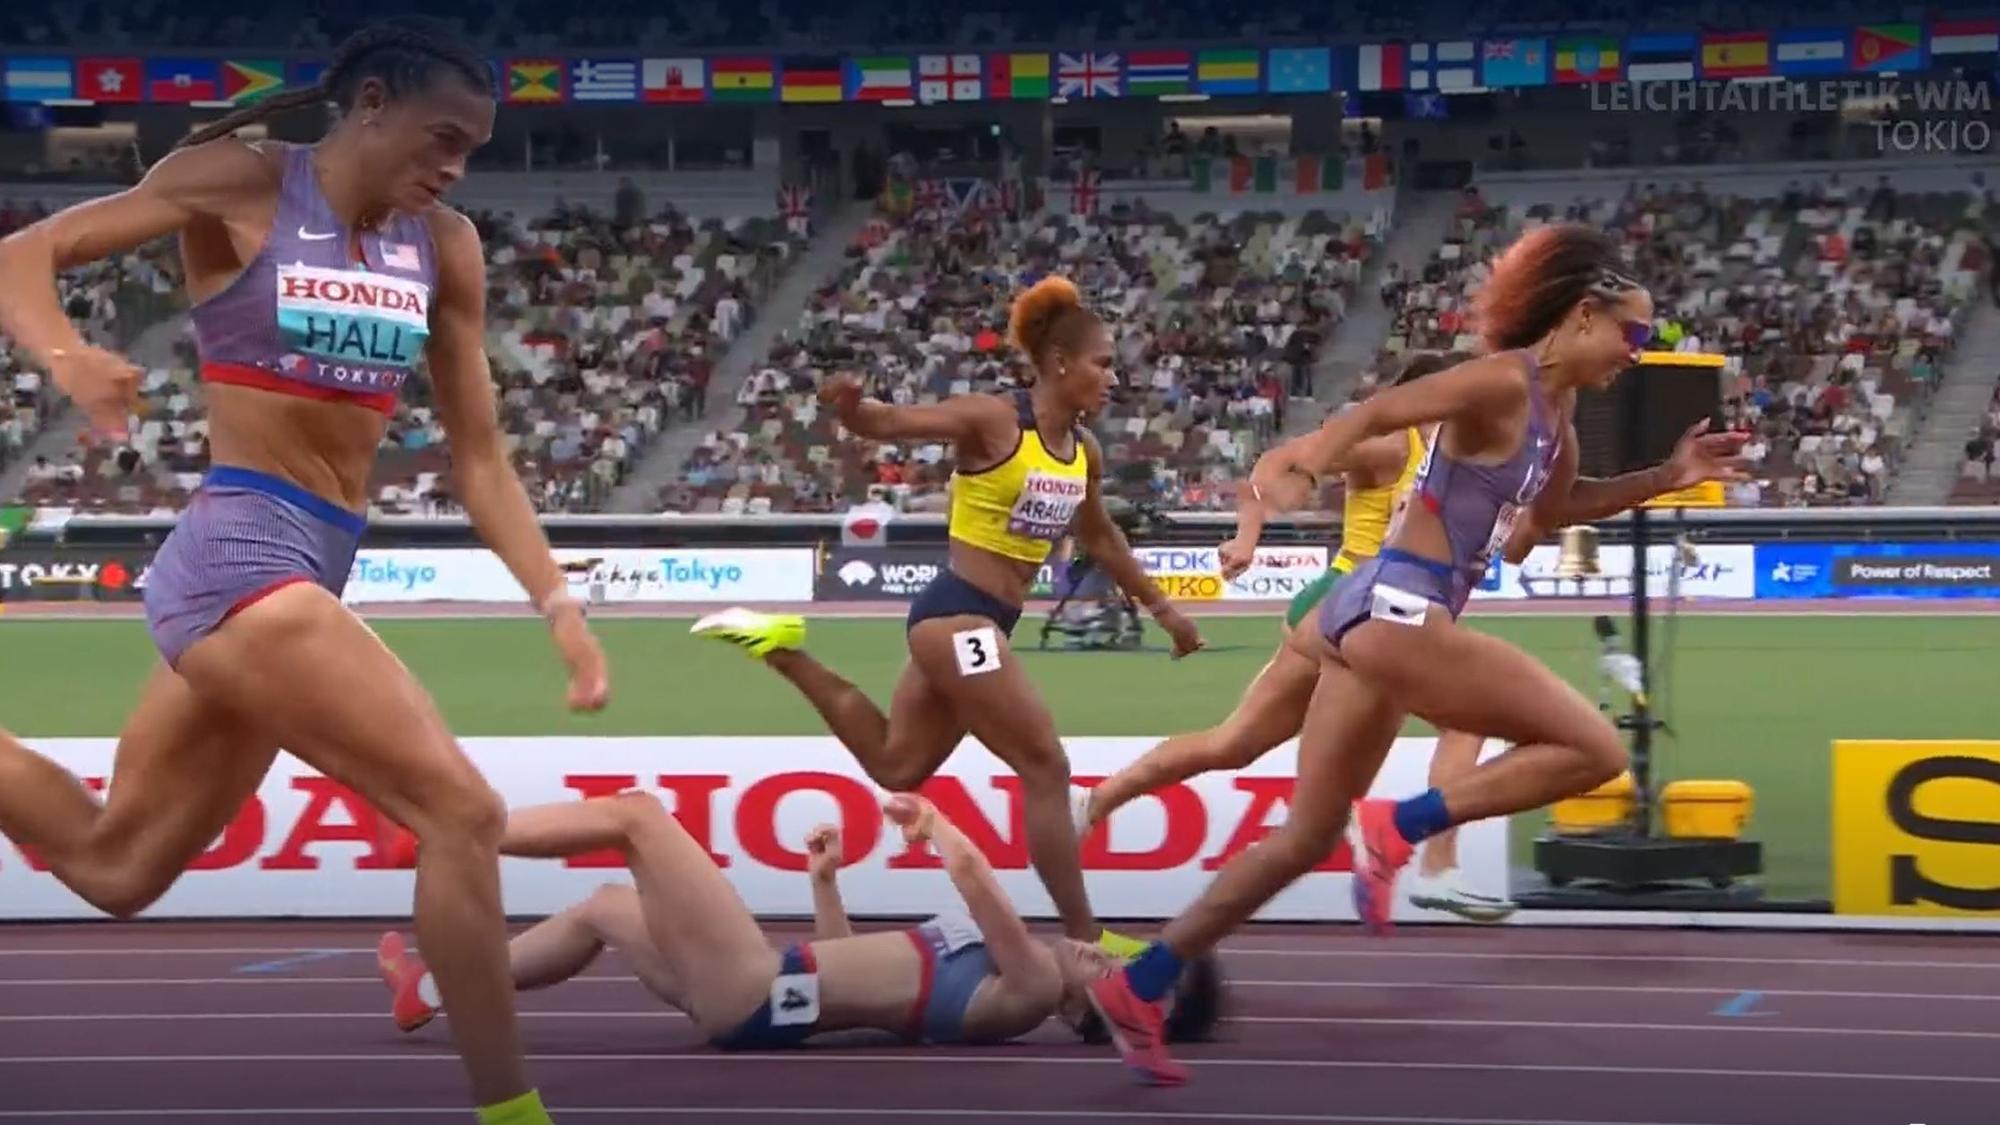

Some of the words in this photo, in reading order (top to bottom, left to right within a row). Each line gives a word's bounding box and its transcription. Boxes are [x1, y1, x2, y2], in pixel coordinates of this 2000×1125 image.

[282, 276, 424, 316] HONDA
[305, 315, 408, 362] HALL
[358, 557, 437, 589] Tokyo
[660, 557, 742, 589] Tokyo
[1151, 551, 1210, 570] TDK
[1851, 564, 1900, 579] Power
[1903, 564, 1923, 579] of
[1924, 564, 1991, 581] Respect
[966, 636, 987, 668] 3
[780, 986, 810, 1012] 4
